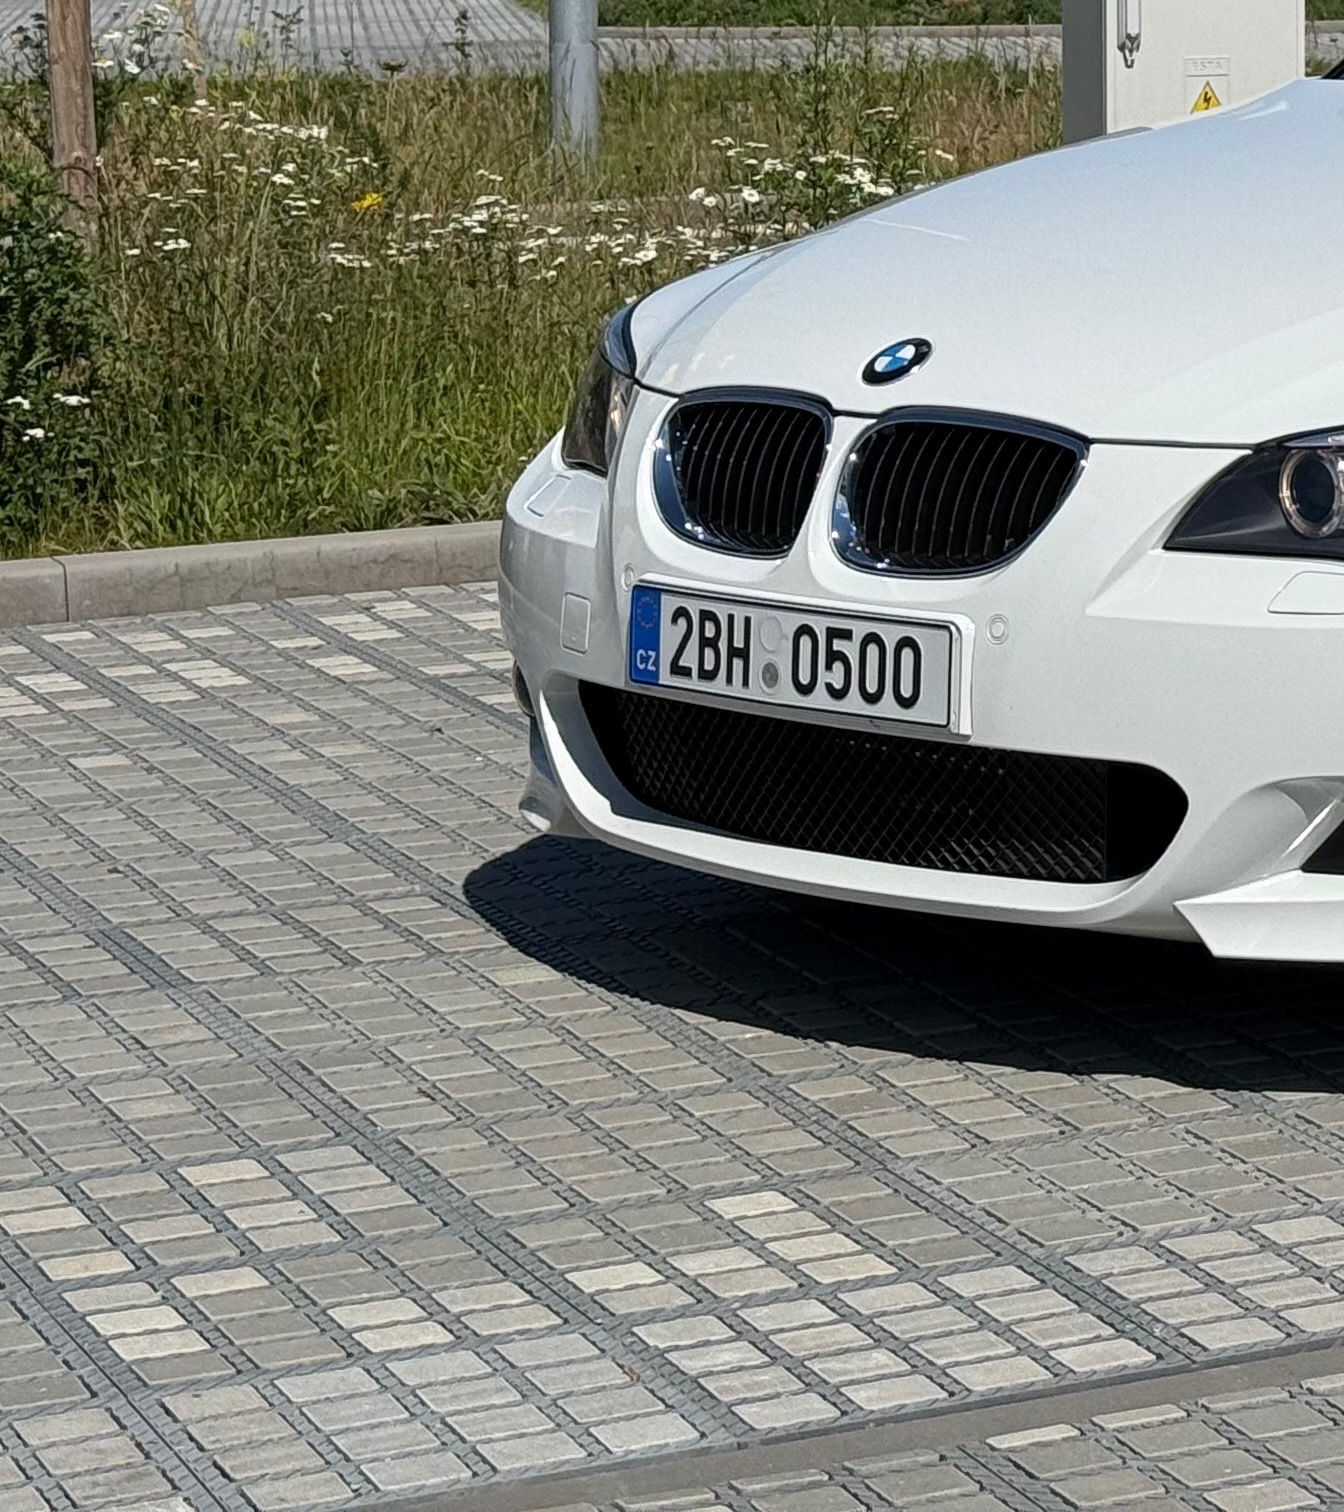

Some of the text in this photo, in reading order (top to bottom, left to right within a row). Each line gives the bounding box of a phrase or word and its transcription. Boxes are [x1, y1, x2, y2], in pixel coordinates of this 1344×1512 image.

[636, 649, 657, 671] CZ
[670, 605, 922, 710] 2BH 0500
